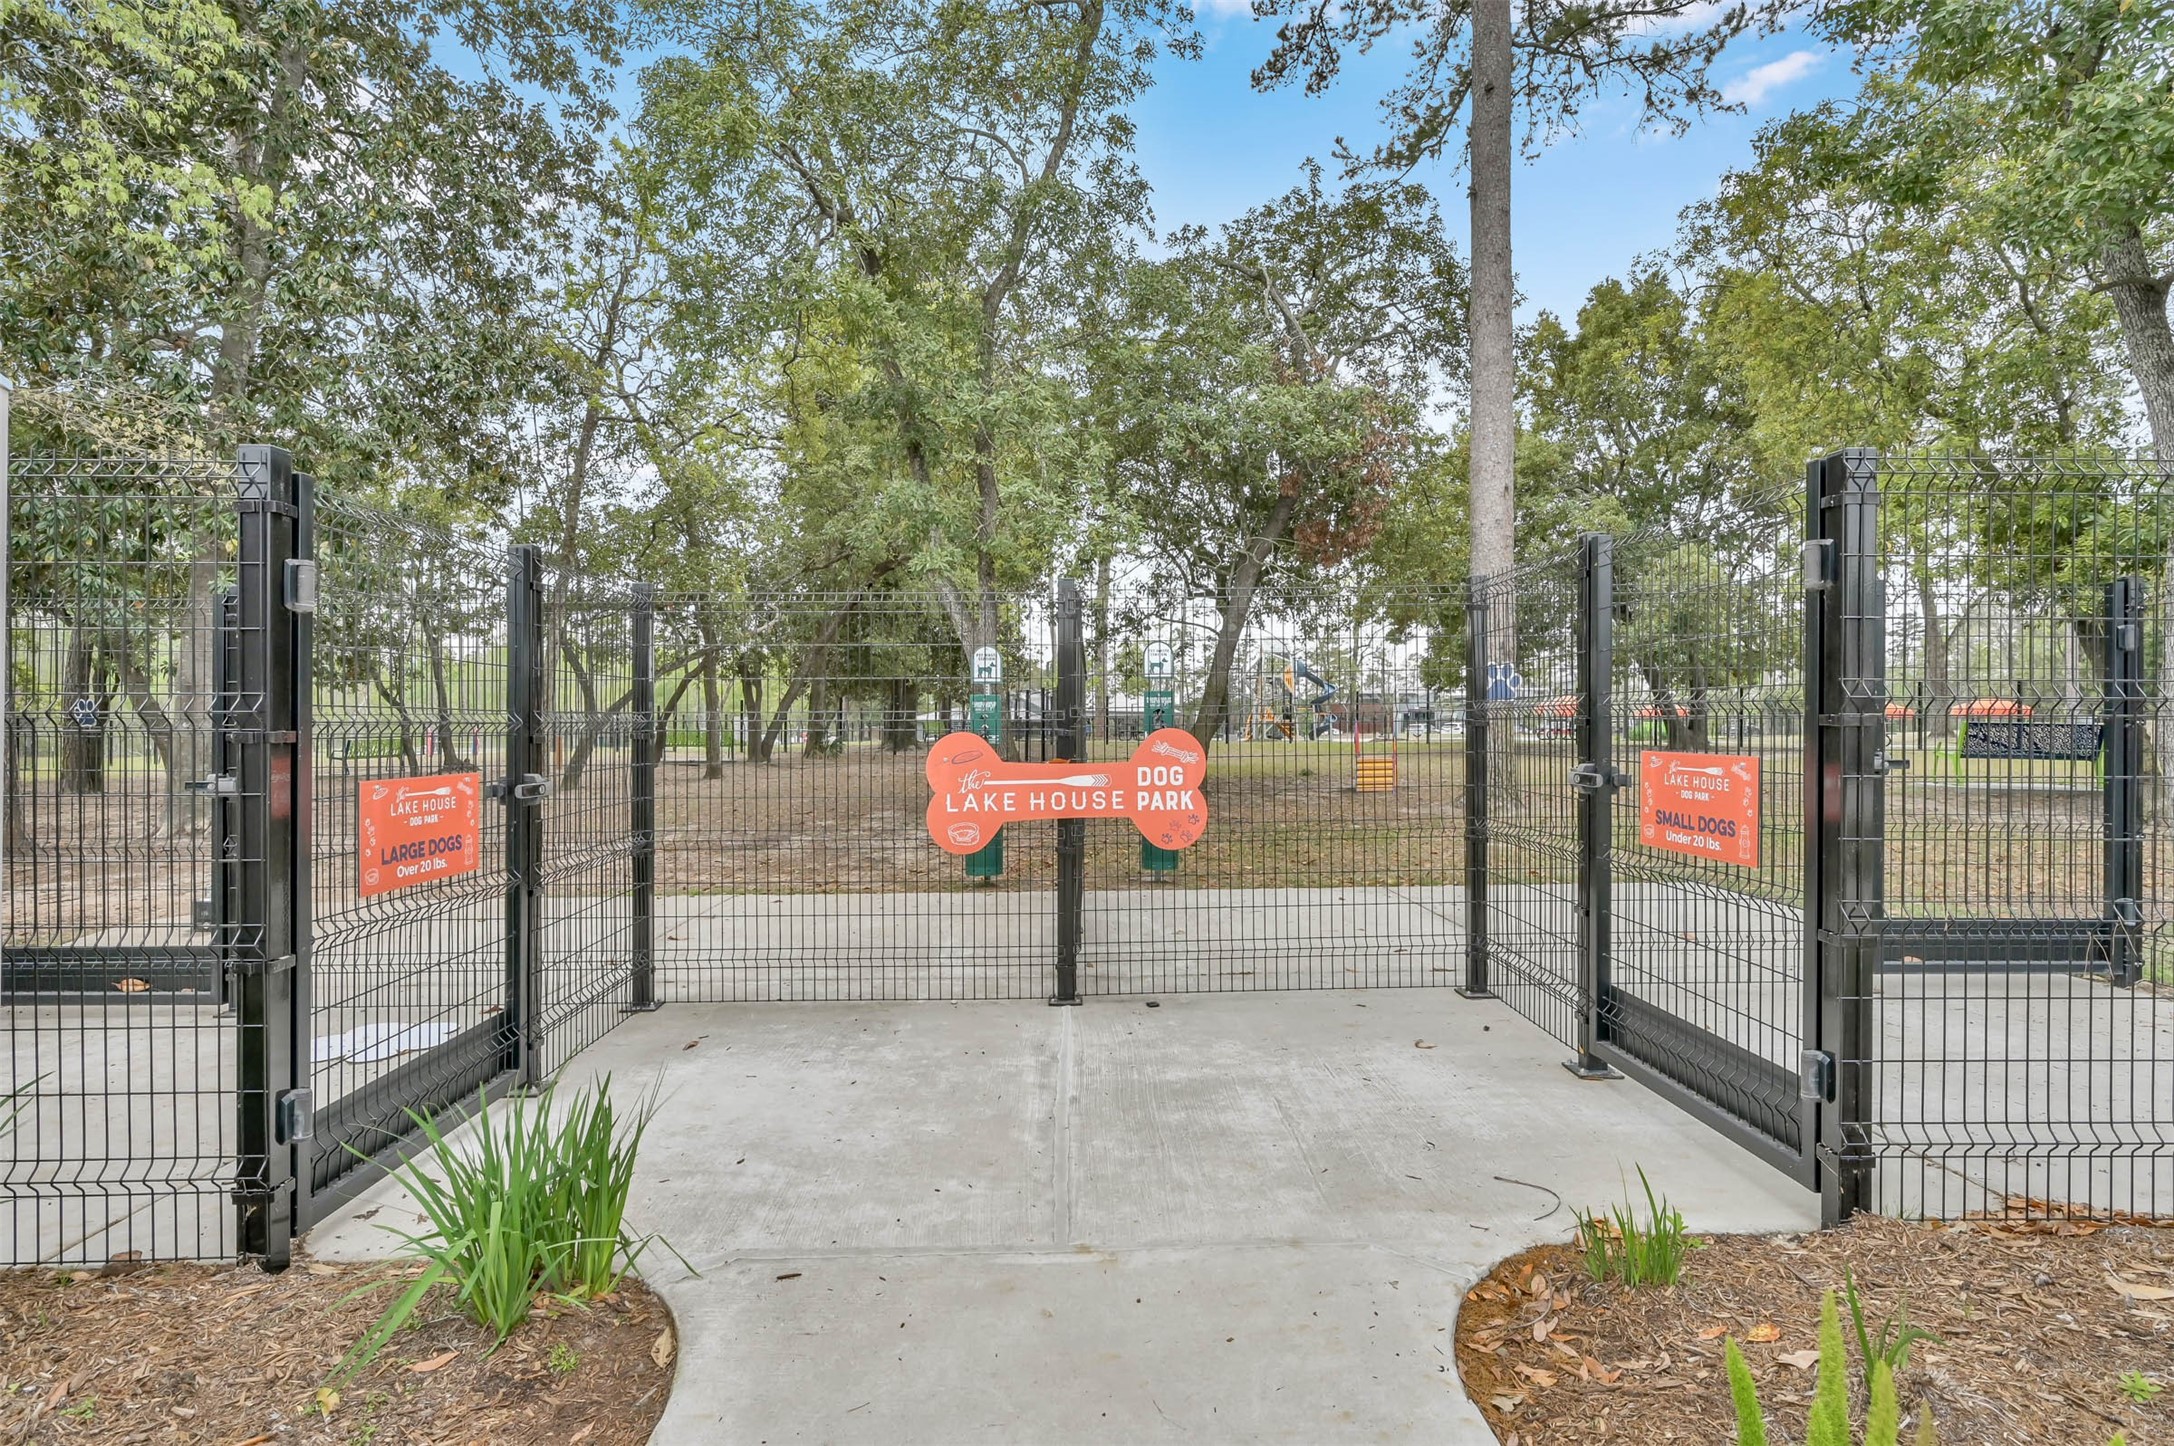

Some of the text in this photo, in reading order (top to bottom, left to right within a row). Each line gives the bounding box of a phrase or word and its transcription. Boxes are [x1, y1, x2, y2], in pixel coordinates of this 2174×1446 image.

[957, 769, 991, 794] the
[1137, 766, 1184, 787] DOG
[1664, 773, 1730, 792] LAKE HOUSE
[945, 790, 1124, 812] LAKE HOUSE
[1137, 790, 1194, 811] PARK
[1680, 789, 1710, 801] DOG PARK
[390, 796, 457, 816] LAKE HOUSE
[409, 815, 439, 826] DOG PARK
[1655, 809, 1736, 838] SMALL DOGS
[381, 834, 462, 866] LARGE DOGS
[1665, 830, 1722, 851] Under 20 lbs.
[396, 857, 448, 878] Over 20 lbs.
